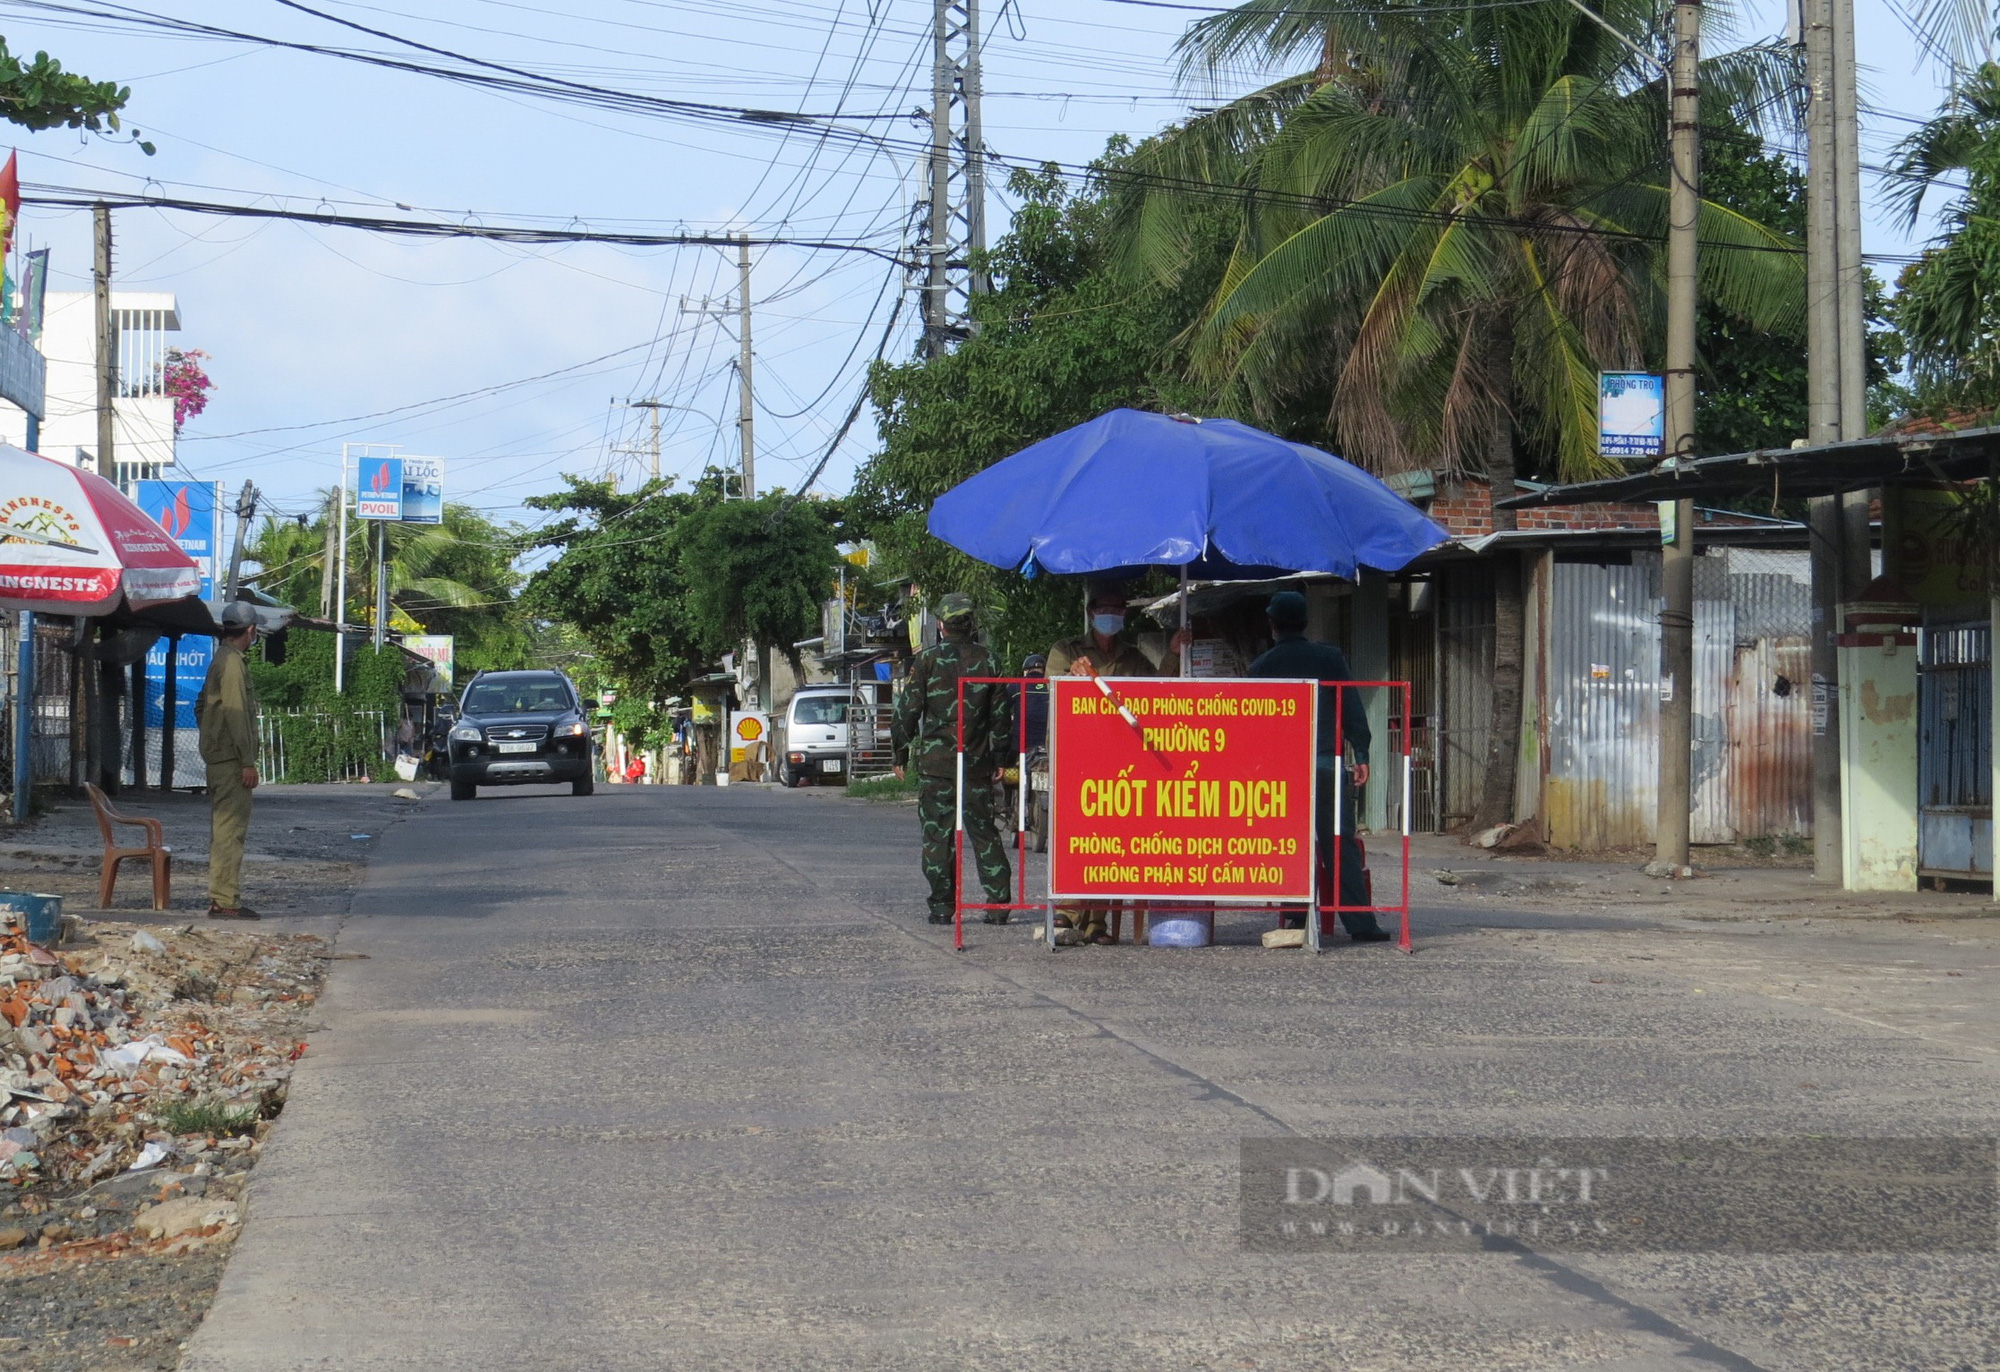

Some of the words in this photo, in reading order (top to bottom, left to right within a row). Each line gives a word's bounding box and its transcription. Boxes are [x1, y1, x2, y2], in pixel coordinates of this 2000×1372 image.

[361, 503, 397, 515] PVOIL
[1071, 696, 1097, 715] BAN
[1153, 692, 1194, 716] PHÒNG
[1196, 691, 1238, 717] CHỐNG
[1241, 698, 1296, 717] COVID-19
[1142, 721, 1210, 752] PHƯỜNG
[1214, 728, 1226, 752] 9
[1080, 764, 1147, 817] CHỐT
[1156, 760, 1220, 818] KIỂM
[1229, 780, 1287, 827] DỊCH
[1069, 832, 1126, 858] PHÒNG,
[1130, 830, 1182, 856] CHỐNG
[1187, 837, 1223, 859] DỊCH
[1227, 837, 1297, 856] COVID-19
[1083, 862, 1139, 885] (KHÔNG
[1143, 862, 1184, 887] PHẬN
[1188, 864, 1209, 887] SỰ
[1212, 860, 1245, 884] CẤM
[1248, 862, 1283, 885] VÀO)
